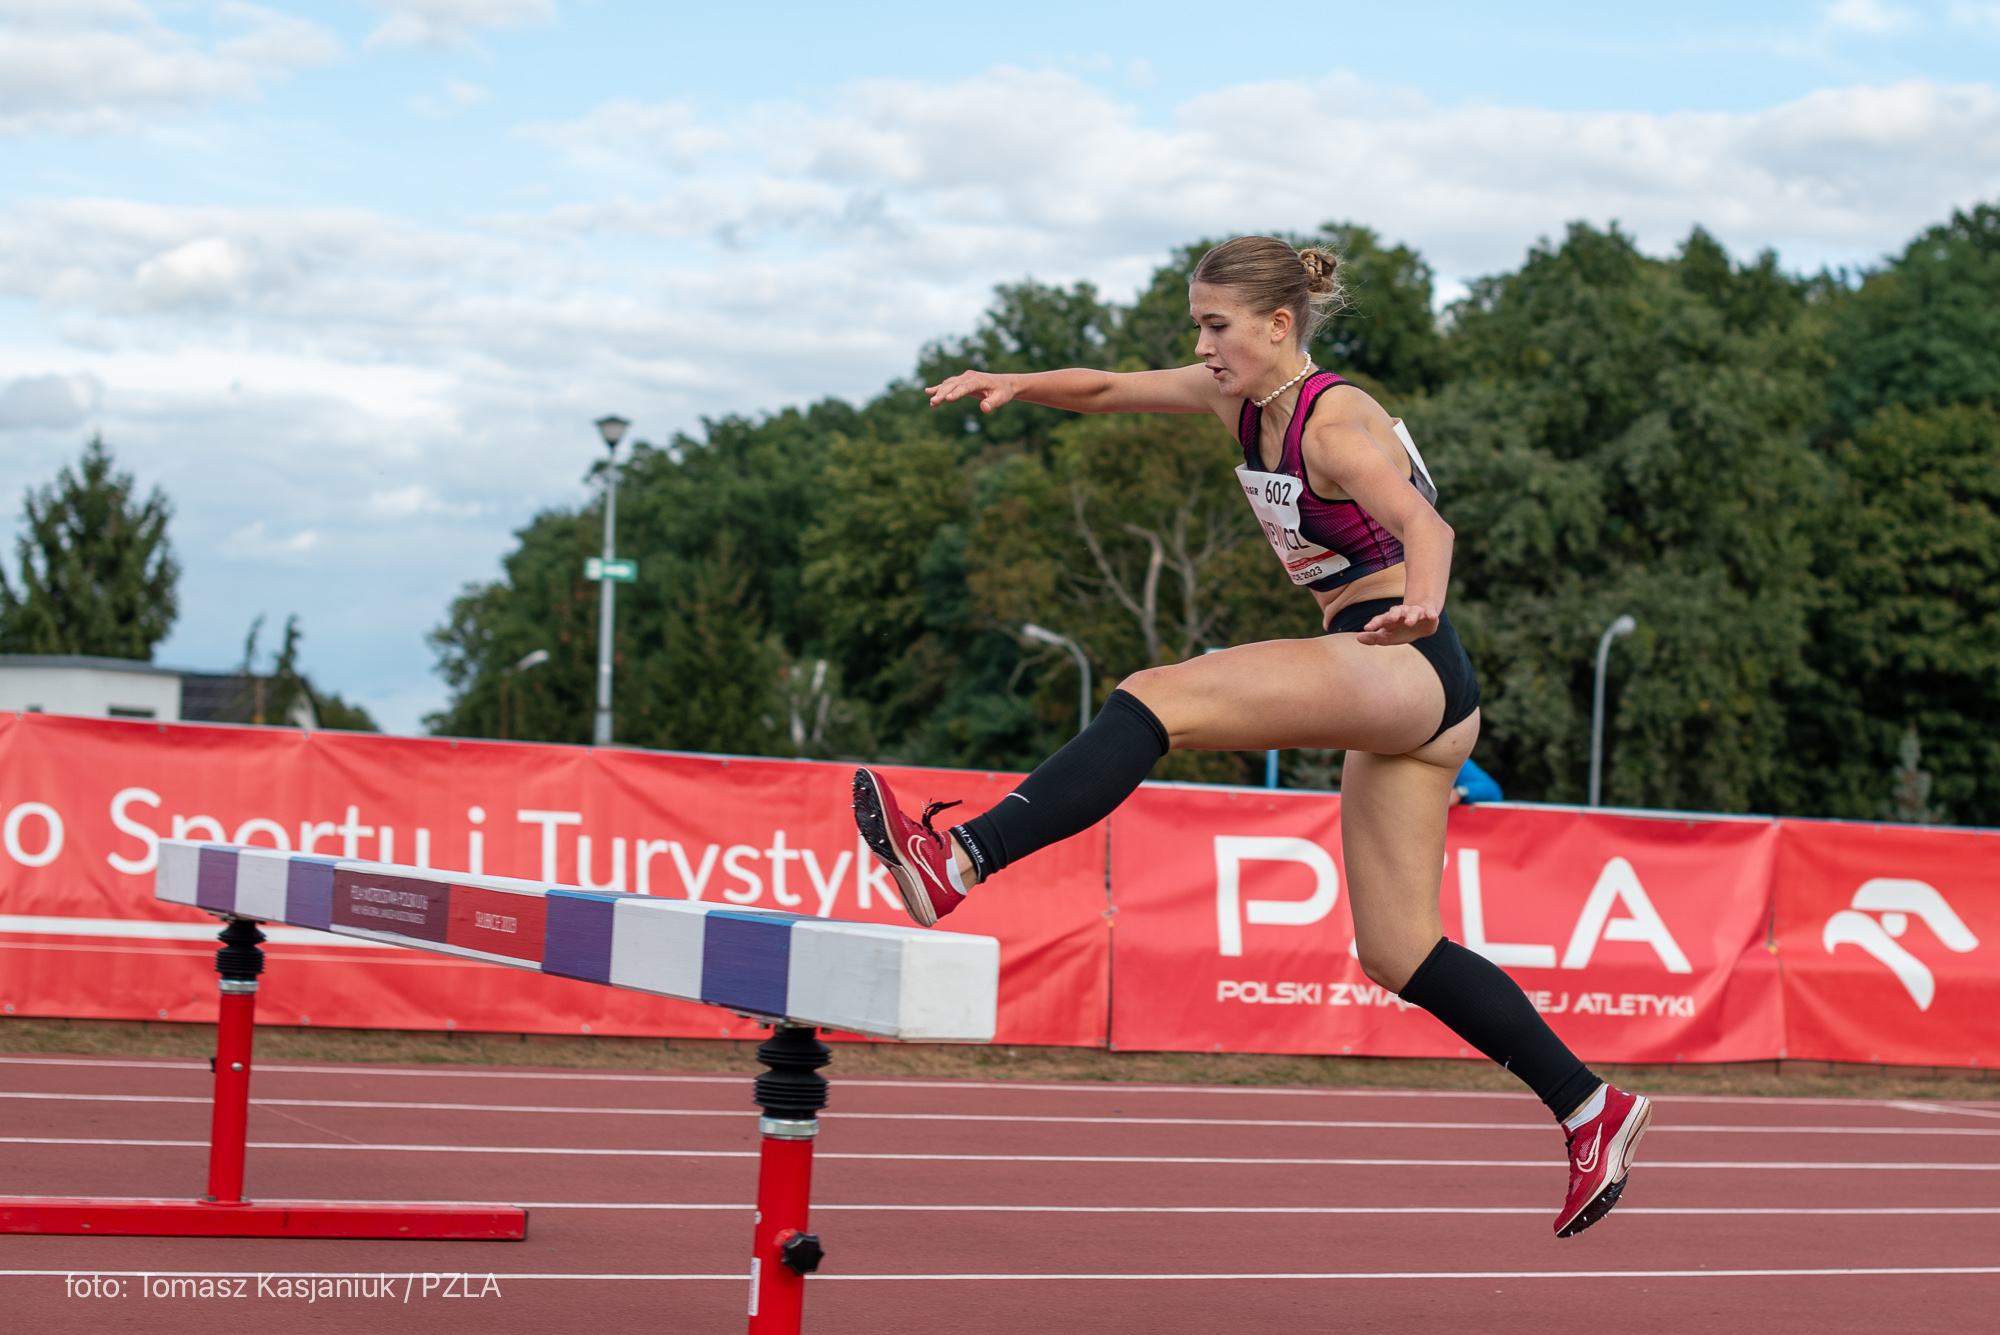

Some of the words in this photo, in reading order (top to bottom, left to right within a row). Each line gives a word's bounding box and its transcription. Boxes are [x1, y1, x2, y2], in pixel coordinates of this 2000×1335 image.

[1265, 480, 1291, 506] 602
[1303, 566, 1323, 579] 2023
[3, 802, 65, 867] o
[468, 806, 486, 876] i
[1214, 835, 1693, 974] PLA
[1217, 980, 1322, 1005] POLSKI
[1328, 983, 1422, 1012] ZWIĄ
[1523, 990, 1569, 1013] IEJ
[1573, 992, 1695, 1017] ATLETYKI
